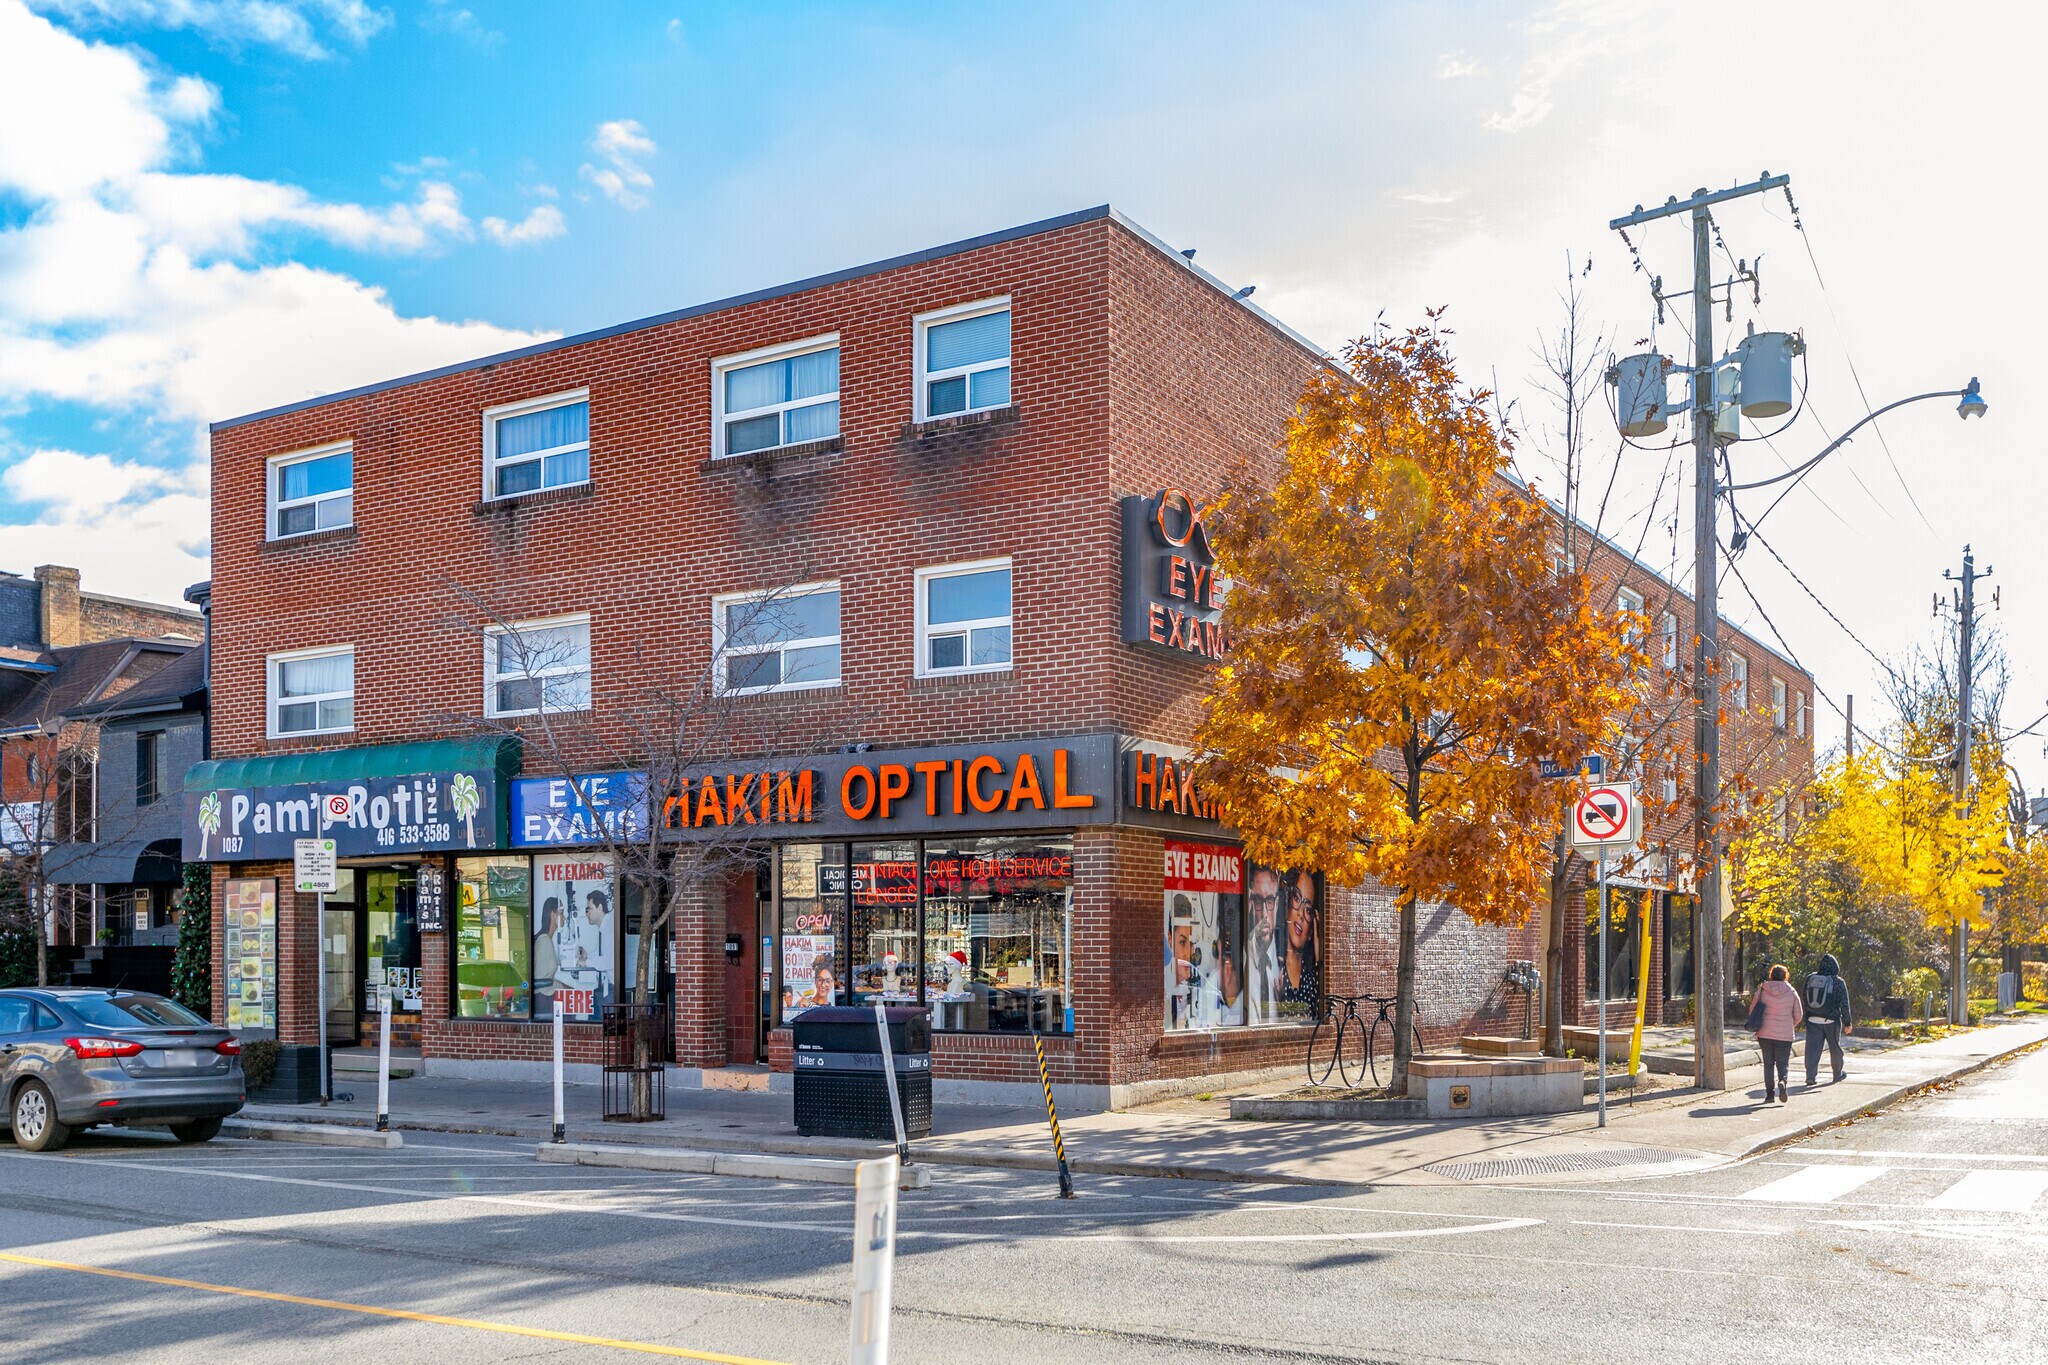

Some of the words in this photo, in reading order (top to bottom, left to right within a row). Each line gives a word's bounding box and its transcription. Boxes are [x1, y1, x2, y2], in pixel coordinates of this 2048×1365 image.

[1170, 554, 1224, 611] EYE
[1149, 601, 1225, 660] EXAM
[549, 776, 610, 808] EYE
[663, 770, 814, 828] HAKIM
[841, 749, 1094, 821] OPTICAL
[1135, 750, 1224, 820] HAK
[348, 780, 424, 829] Roti
[524, 809, 638, 841] EXAMS
[222, 837, 244, 853] 1087
[377, 828, 395, 846] 416
[544, 864, 562, 881] EYE
[565, 862, 605, 881] EXAMS
[856, 861, 917, 879] CONTACT
[929, 858, 959, 879] ONE
[961, 858, 1000, 878] HOUR
[1004, 856, 1072, 876] SERVICE
[1165, 850, 1190, 878] EYE
[1194, 853, 1239, 882] EXAMS
[420, 874, 431, 919] Pam's
[433, 874, 442, 918] Roti
[857, 884, 917, 904] LENSES
[795, 914, 832, 929] OPEN
[784, 937, 812, 949] HAKIM
[785, 953, 797, 966] 60
[785, 968, 790, 979] 2
[553, 989, 594, 1015] HERE
[798, 1056, 815, 1066] Litter
[908, 1058, 921, 1068] Litter
